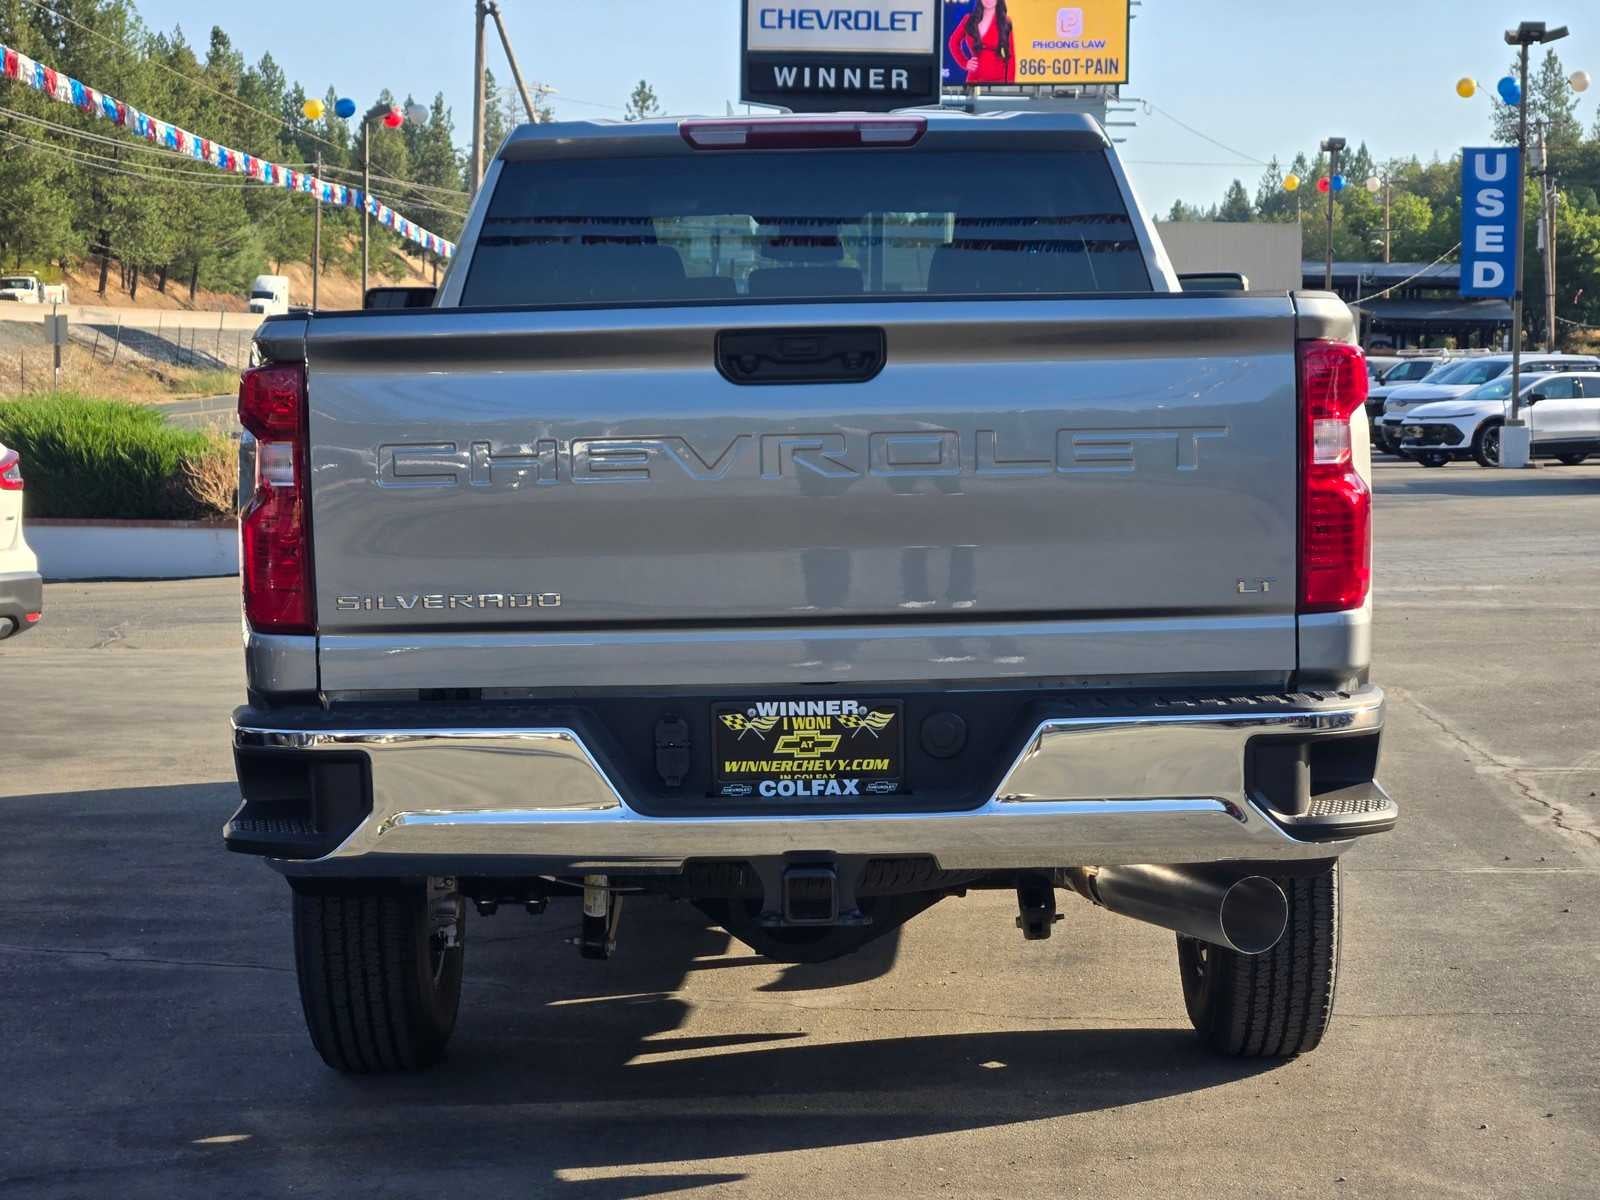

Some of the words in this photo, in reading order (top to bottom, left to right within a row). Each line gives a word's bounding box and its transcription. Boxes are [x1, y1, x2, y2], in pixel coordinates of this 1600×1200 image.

[760, 8, 923, 32] CHEVROLET
[1032, 40, 1079, 49] PHOONG
[1081, 40, 1106, 48] LAW
[1019, 58, 1119, 76] 866-GOT-PAIN
[774, 66, 909, 90] WINNER
[1472, 153, 1507, 289] USED
[376, 425, 1230, 489] CHEVROLET
[1236, 576, 1278, 594] LT
[335, 592, 562, 611] SILVERADO
[755, 701, 858, 716] WINNER
[783, 717, 788, 730] I
[792, 717, 832, 730] WON!
[800, 741, 814, 749] AT
[724, 759, 889, 772] WINNERCHEVY.COM
[759, 779, 860, 797] COLFAX
